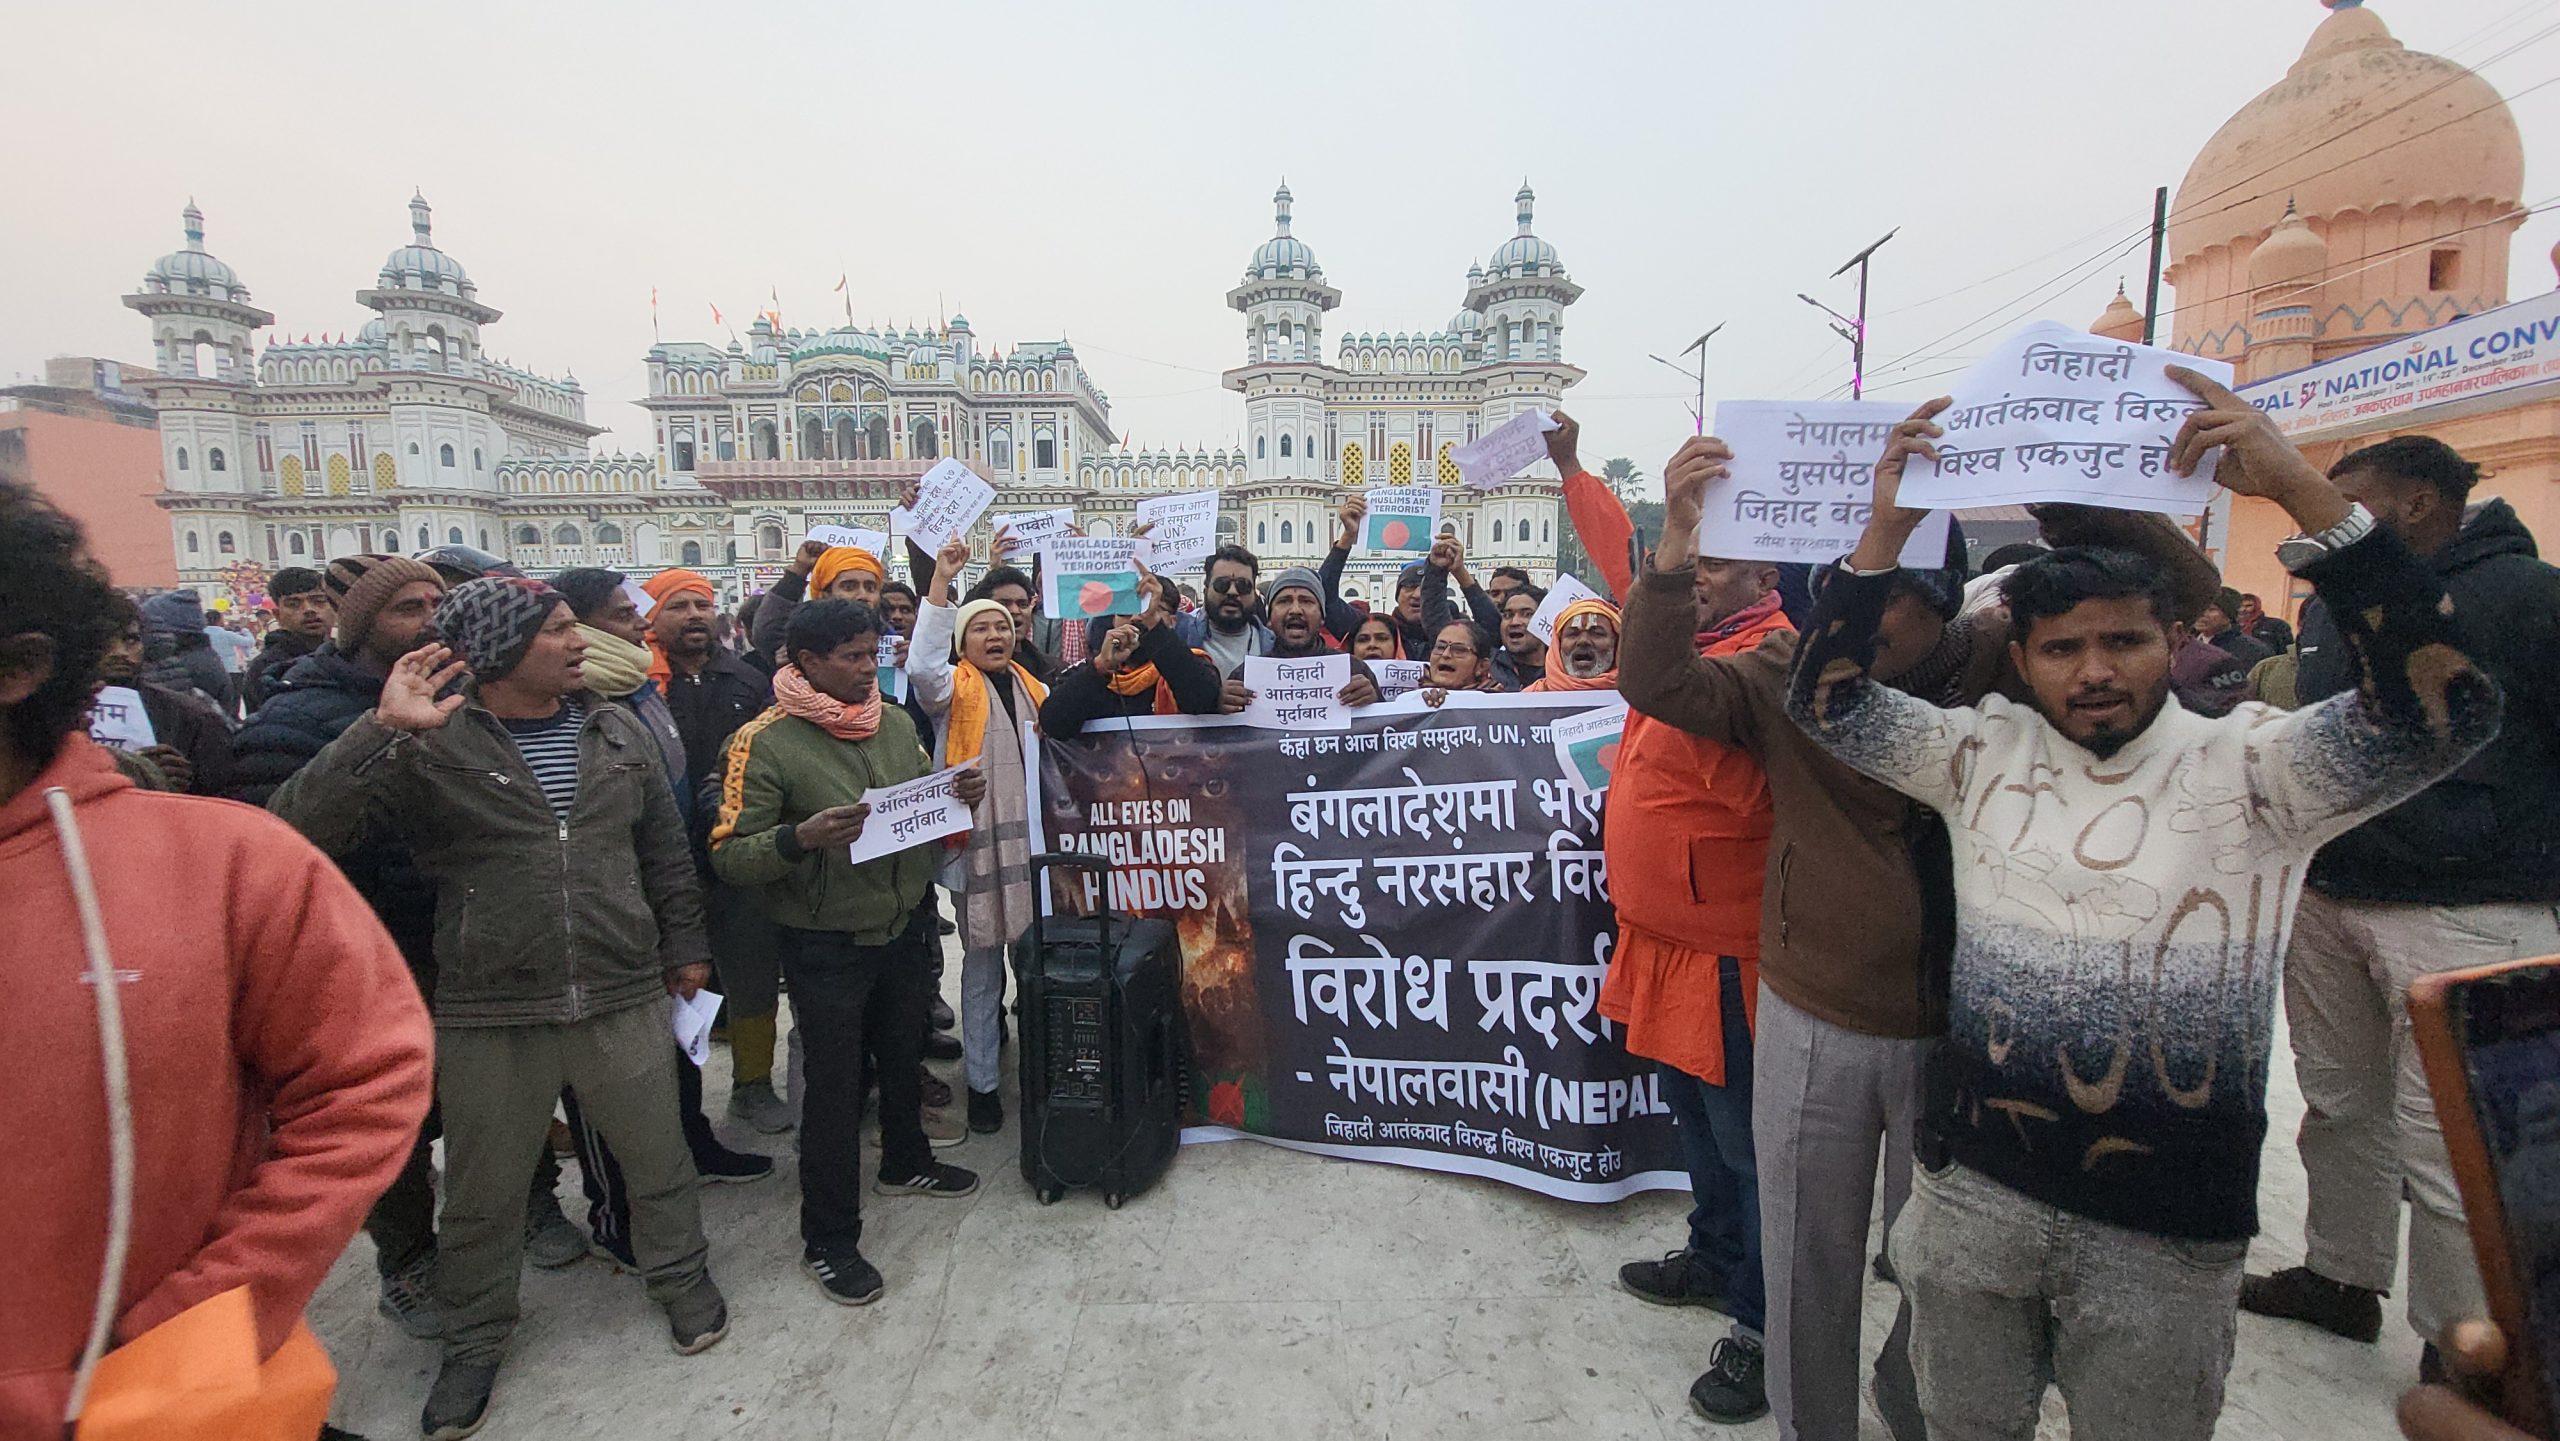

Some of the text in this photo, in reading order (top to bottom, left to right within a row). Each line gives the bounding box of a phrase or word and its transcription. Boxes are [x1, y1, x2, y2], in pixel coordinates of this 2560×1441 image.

[2022, 342, 2135, 381] जिहादी
[2325, 345, 2458, 397] NATIONAL
[2469, 315, 2560, 359] CONV
[1948, 393, 2104, 431] आतंकवाद
[1779, 451, 1874, 495] घुसपैठ
[1934, 444, 2005, 479] विश्व
[2015, 441, 2131, 479] एकजुट
[1188, 500, 1209, 510] आज
[1370, 489, 1430, 497] BANGLADESHI
[1375, 505, 1425, 513] TERRORIST
[1734, 490, 1822, 528] जिहाद
[927, 515, 952, 535] हिन्दु
[943, 500, 960, 515] देश
[827, 534, 858, 545] BAN
[1051, 540, 1136, 550] BANGLADESHI
[1055, 550, 1135, 560] MUSLIMS ARE
[1062, 561, 1127, 571] TERRORIST
[1277, 662, 1325, 681] जिहादी
[1385, 664, 1422, 681] जिहादी
[1265, 685, 1333, 701] आतंकवाद
[1276, 704, 1328, 724] मुर्दाबाद
[1559, 723, 1584, 738] जिहादी
[1279, 725, 1554, 759] कंहा छन आज विश्व समुदाय, UN, शा
[1090, 799, 1191, 826] ALL EYES ON
[1287, 767, 1517, 841] बंगलादेशमा
[891, 807, 947, 842] मुर्दाबाद
[1059, 827, 1225, 867] BANGLADESH
[1082, 868, 1208, 912] HINDUS
[1271, 842, 1366, 930] हिन्दु
[1373, 837, 1534, 913] नरसंहार
[1285, 934, 1451, 1032] विरोध
[1325, 1037, 1529, 1120] नेपालवासी
[1536, 1072, 1676, 1130] (NEPAL
[1325, 1113, 1374, 1141] जिहादी
[1379, 1118, 1451, 1147] आतंकवाद
[1454, 1120, 1498, 1154] विरुद्ध
[1501, 1127, 1535, 1161] विश्व
[1538, 1143, 1593, 1181] एकजुट
